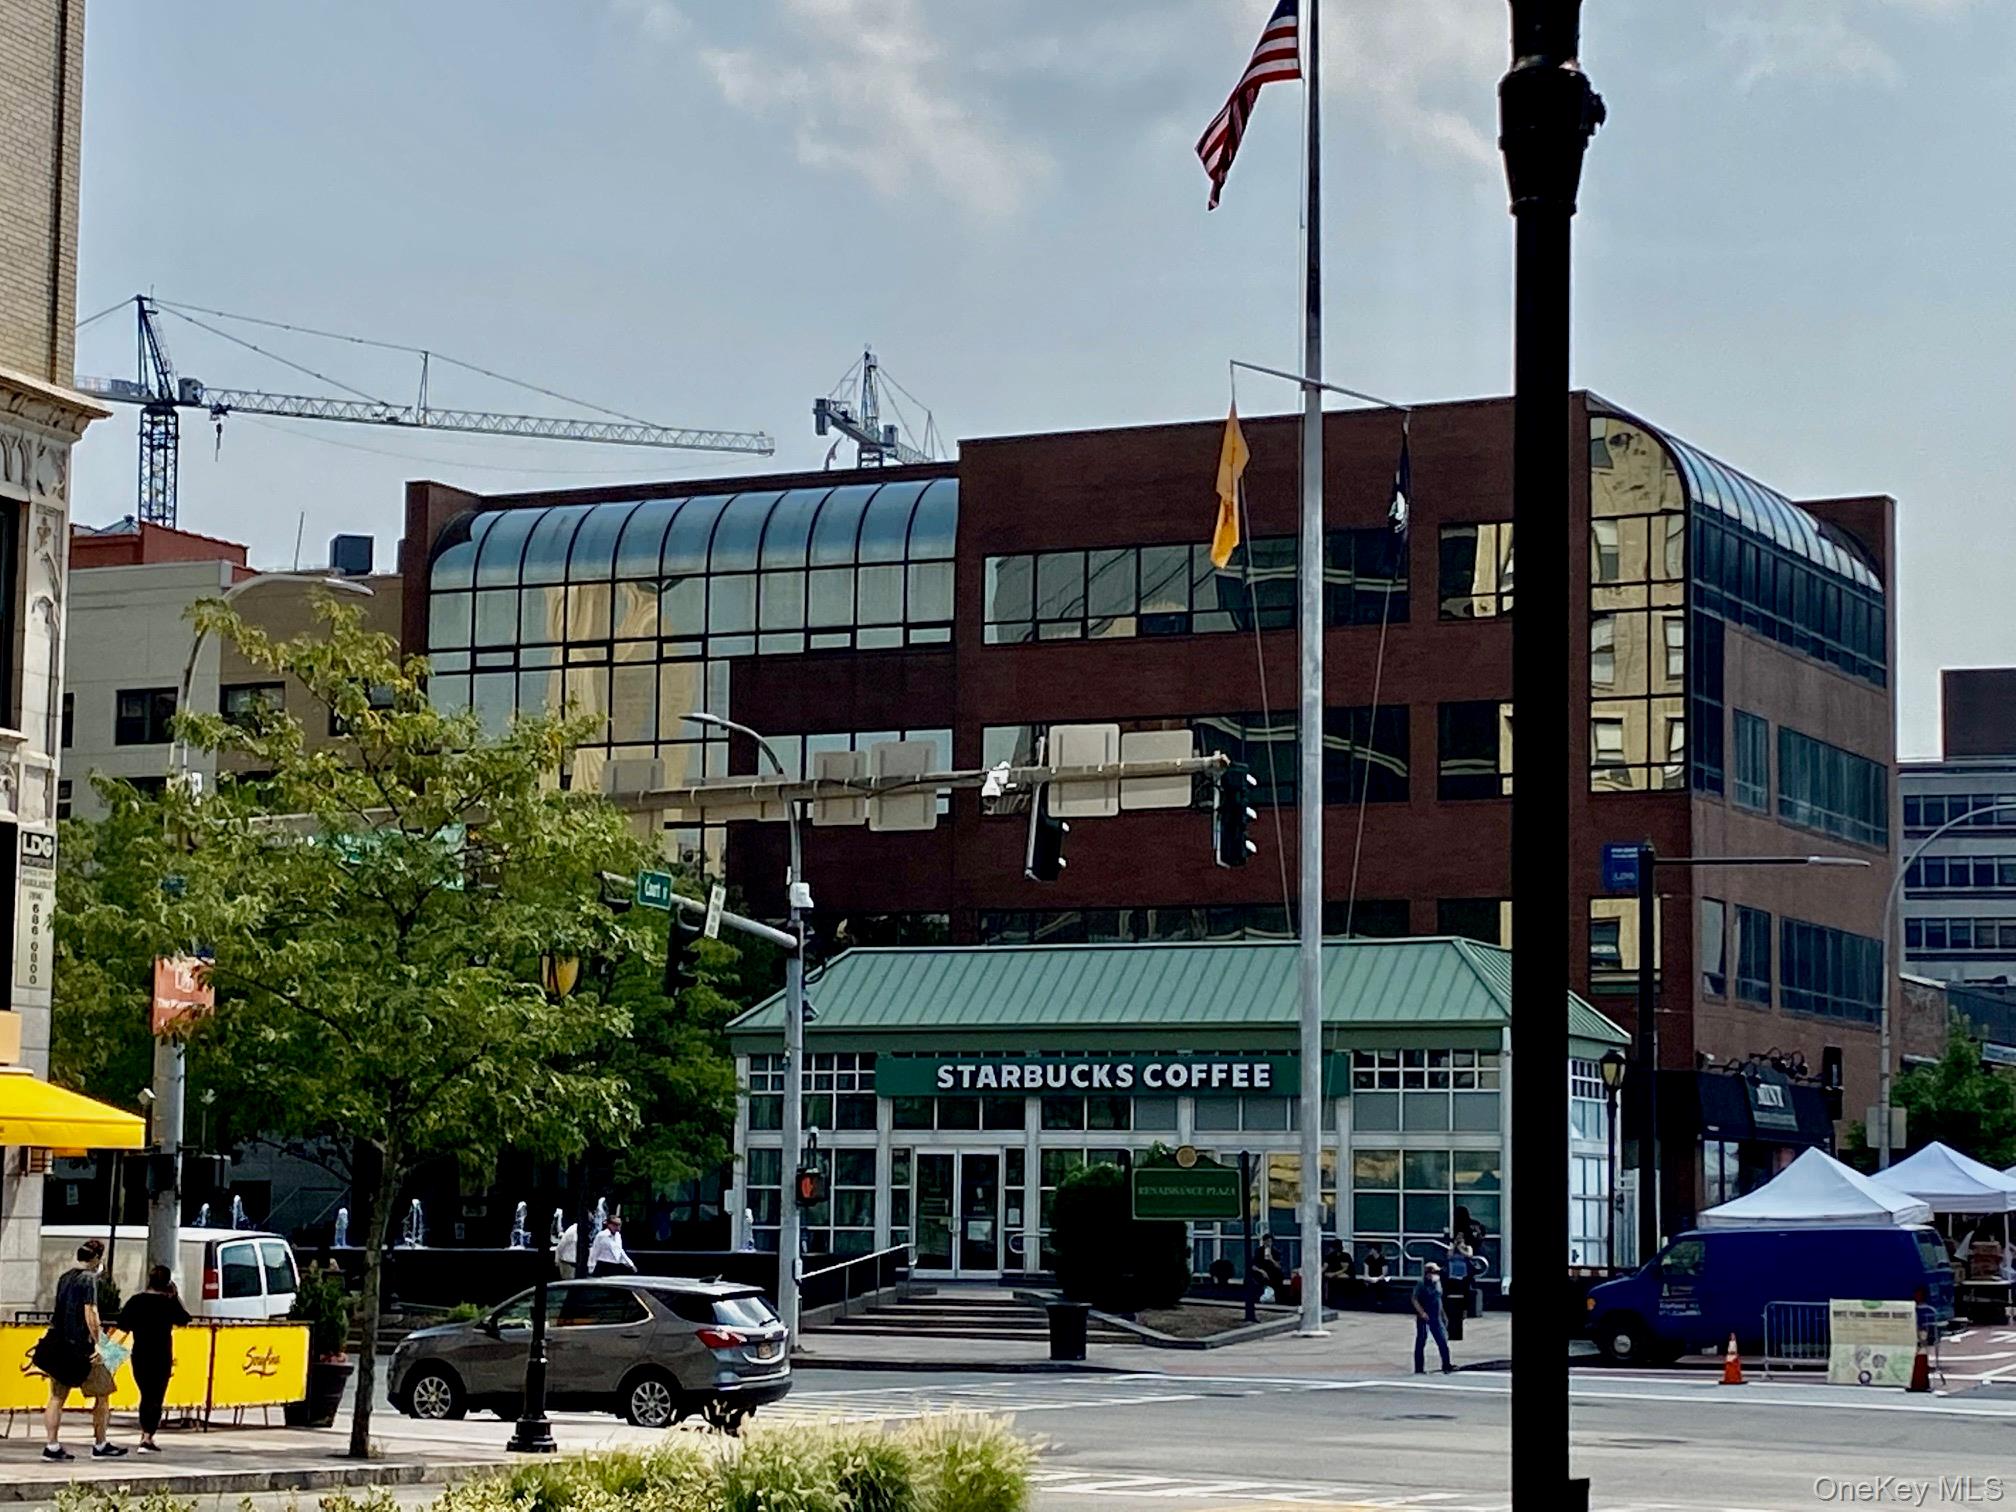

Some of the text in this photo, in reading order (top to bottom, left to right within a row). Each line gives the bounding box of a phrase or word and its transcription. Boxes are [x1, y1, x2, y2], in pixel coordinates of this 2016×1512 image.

[22, 832, 54, 858] LDG
[936, 1062, 1271, 1089] STARBUCKS COFFEE
[1137, 1185, 1237, 1198] RENAISSANCE PLAZA
